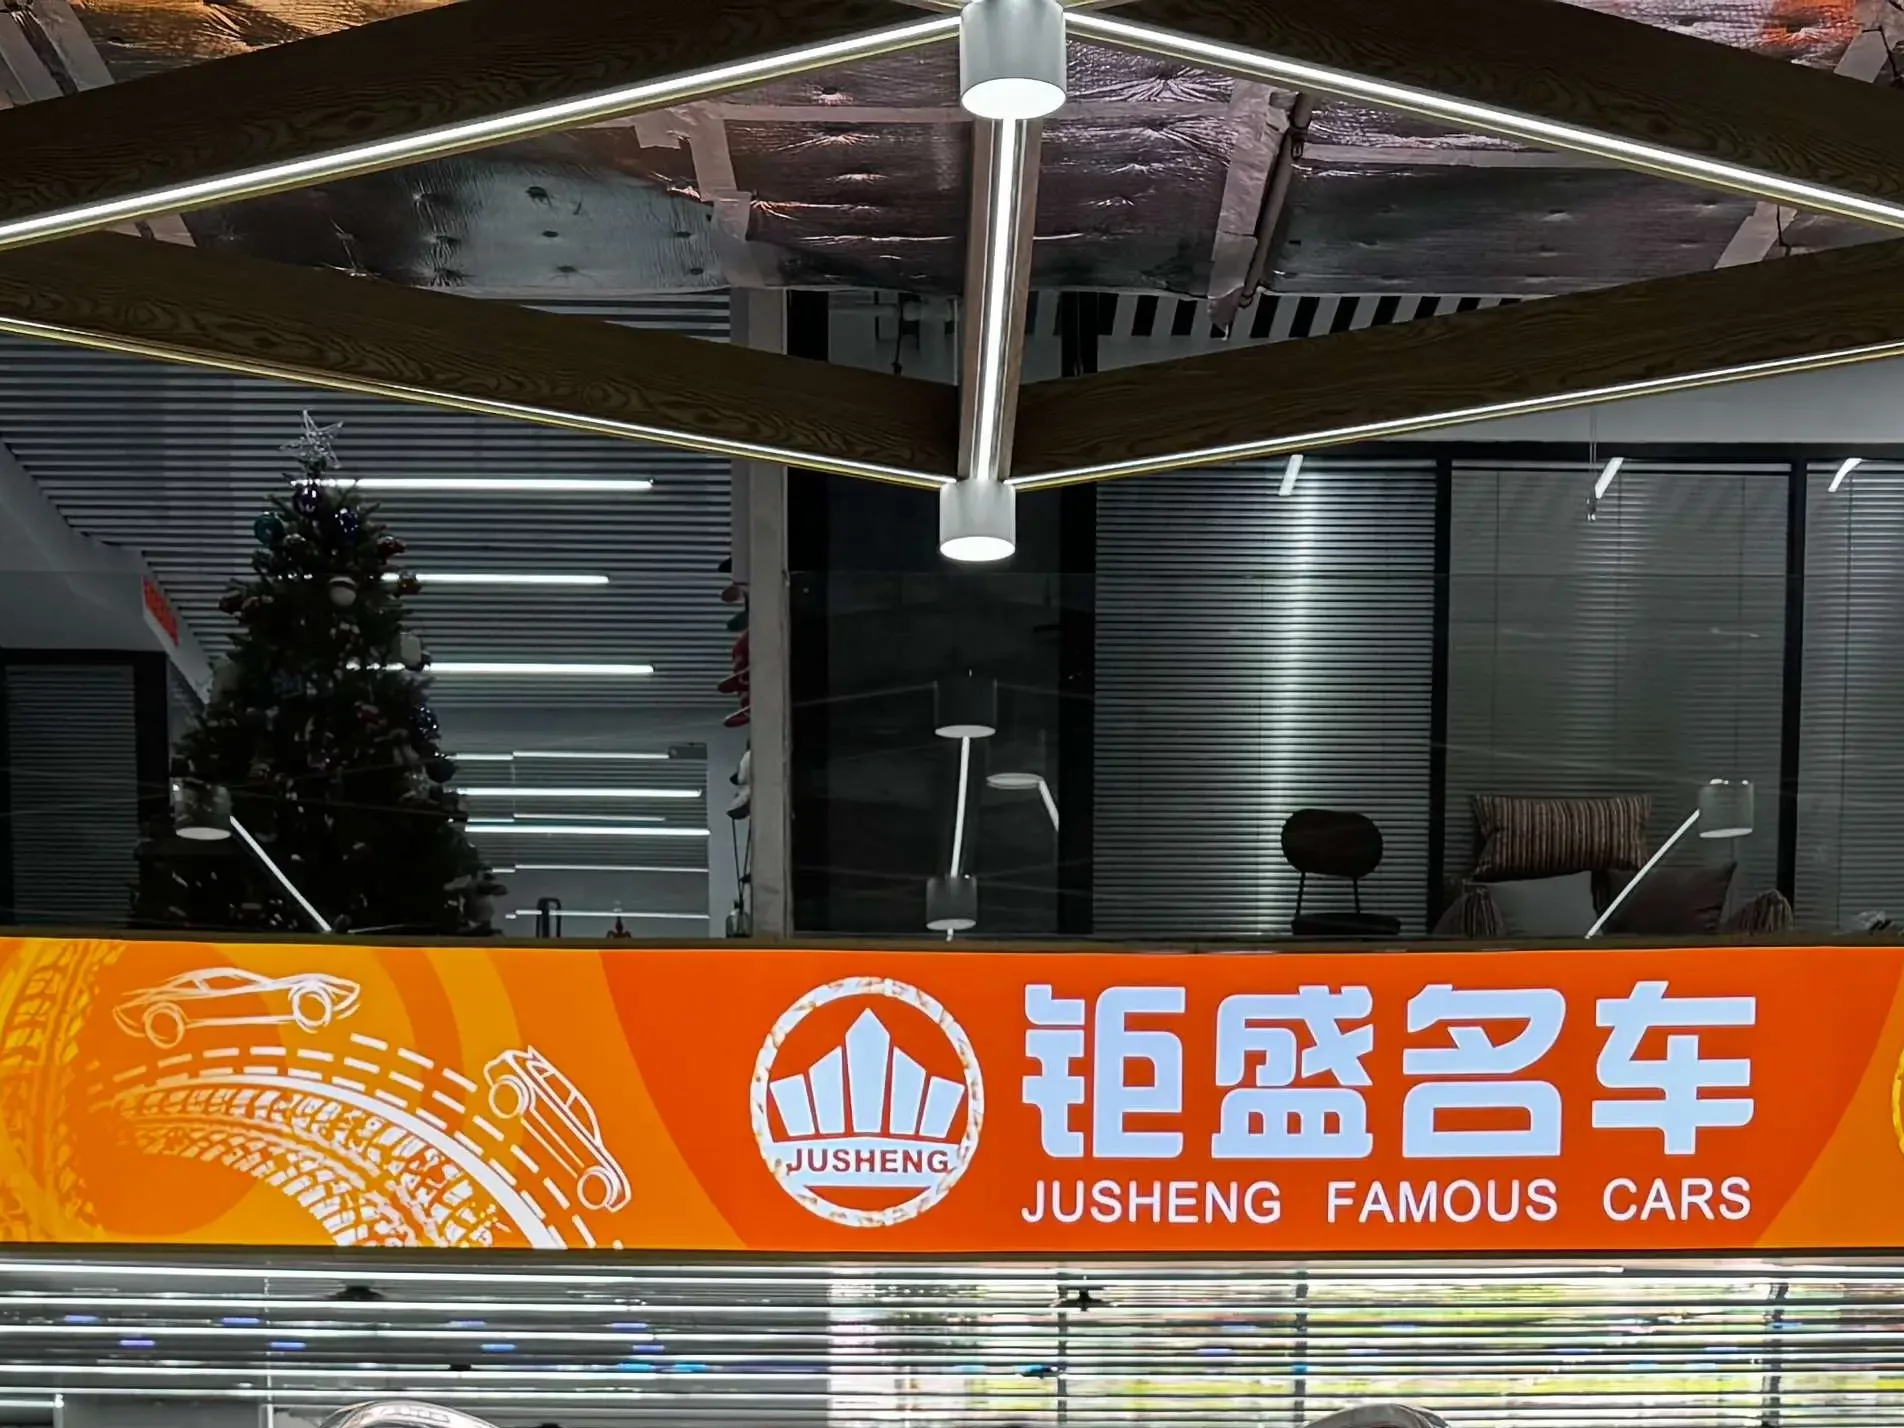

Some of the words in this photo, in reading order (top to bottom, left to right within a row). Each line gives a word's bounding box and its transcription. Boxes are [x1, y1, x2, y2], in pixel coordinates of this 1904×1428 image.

[1021, 980, 1756, 1160] 钜盛名车
[786, 1148, 950, 1174] JUSHENG
[1021, 1180, 1281, 1224] JUSHENG
[1327, 1179, 1558, 1223] FAMOUS
[1602, 1177, 1751, 1221] CARS
